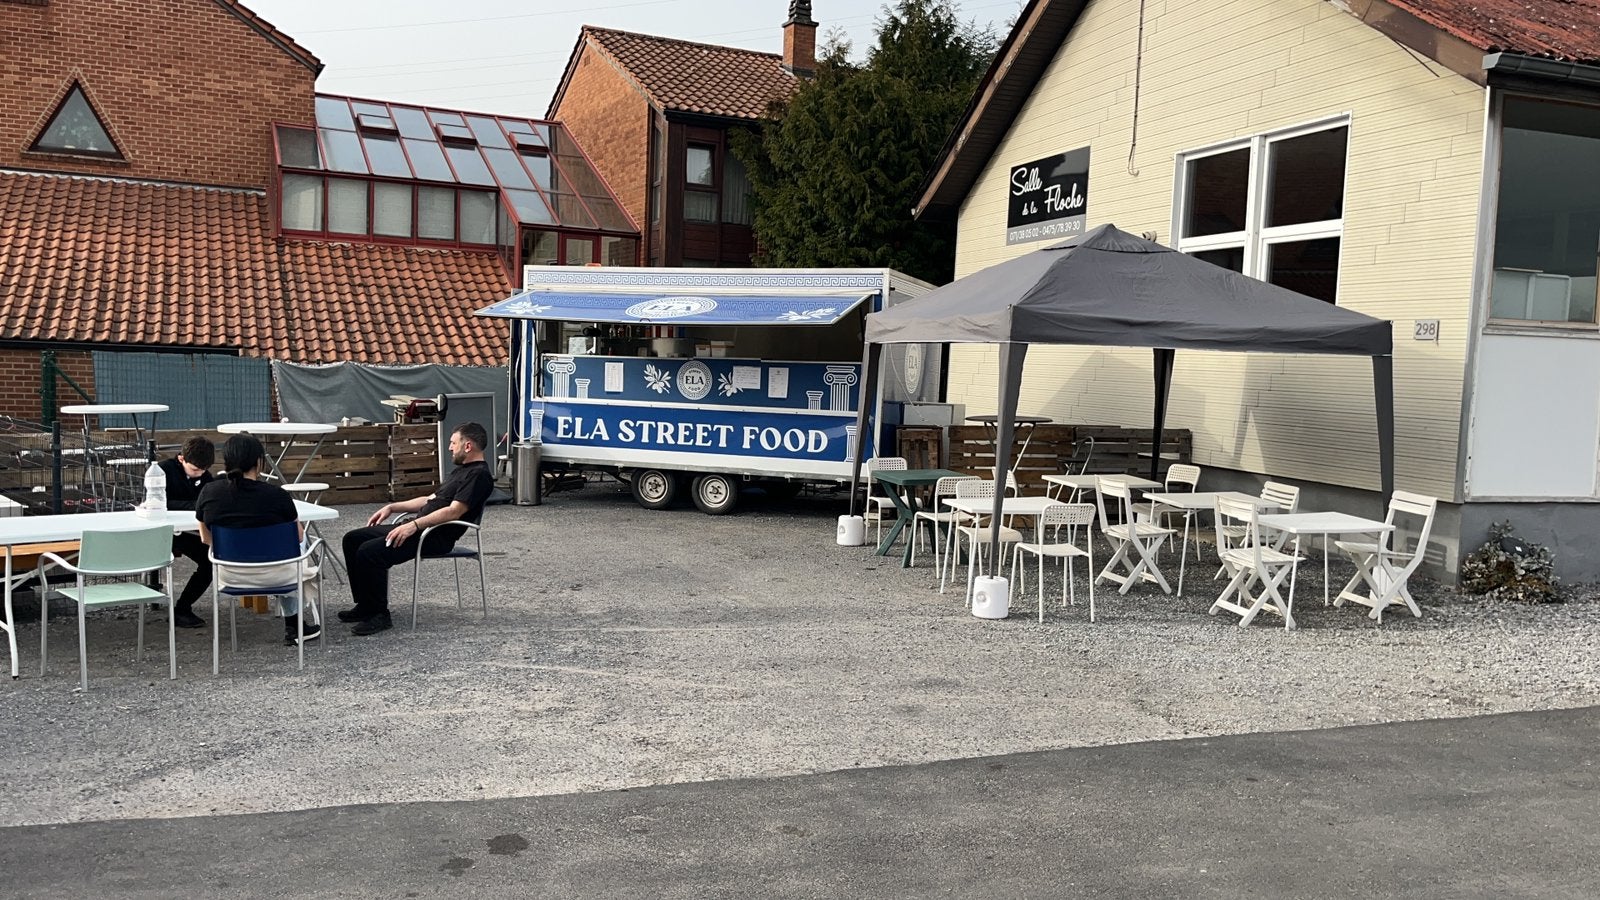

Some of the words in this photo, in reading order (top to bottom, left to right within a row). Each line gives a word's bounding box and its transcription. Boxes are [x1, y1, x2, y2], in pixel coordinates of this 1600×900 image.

[1011, 167, 1043, 196] Salle
[1030, 201, 1038, 214] la
[1044, 183, 1084, 213] Floche
[1072, 220, 1080, 231] 30
[1415, 323, 1436, 336] 298
[685, 375, 704, 385] ELA
[556, 416, 610, 441] ELA
[617, 419, 734, 448] STREET
[742, 426, 829, 453] FOOD
